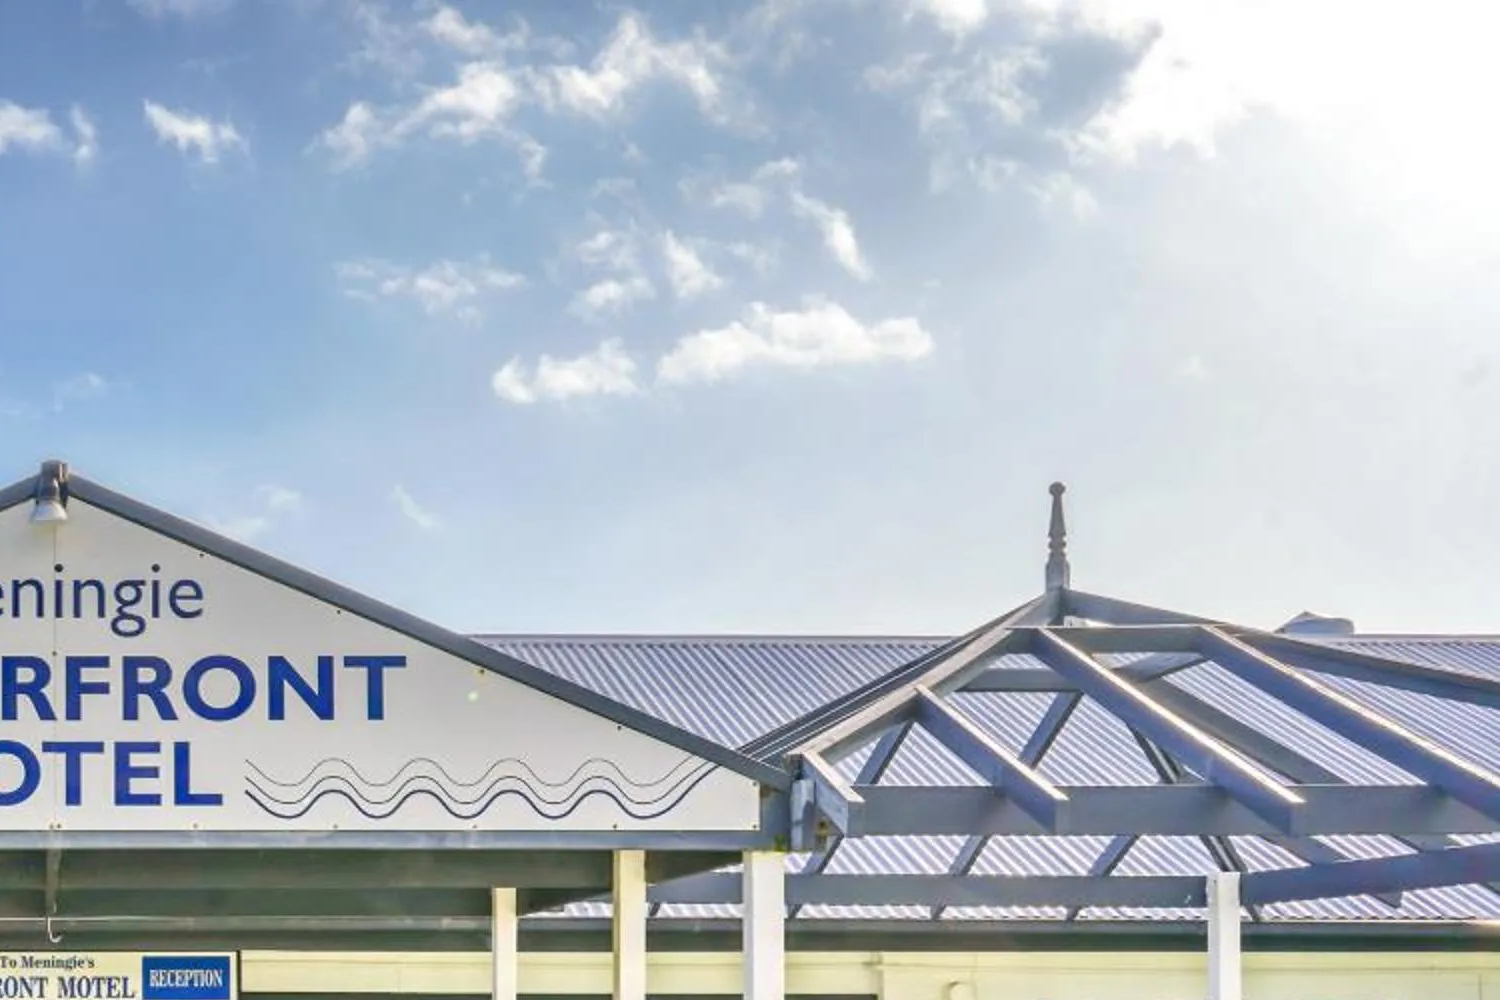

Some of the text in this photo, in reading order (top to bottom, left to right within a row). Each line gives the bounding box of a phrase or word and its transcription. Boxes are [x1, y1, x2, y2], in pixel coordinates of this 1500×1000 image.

[0, 955, 17, 969] To
[20, 955, 95, 970] Meningie's
[57, 975, 136, 999] MOTEL
[149, 968, 224, 988] RECEPTION
